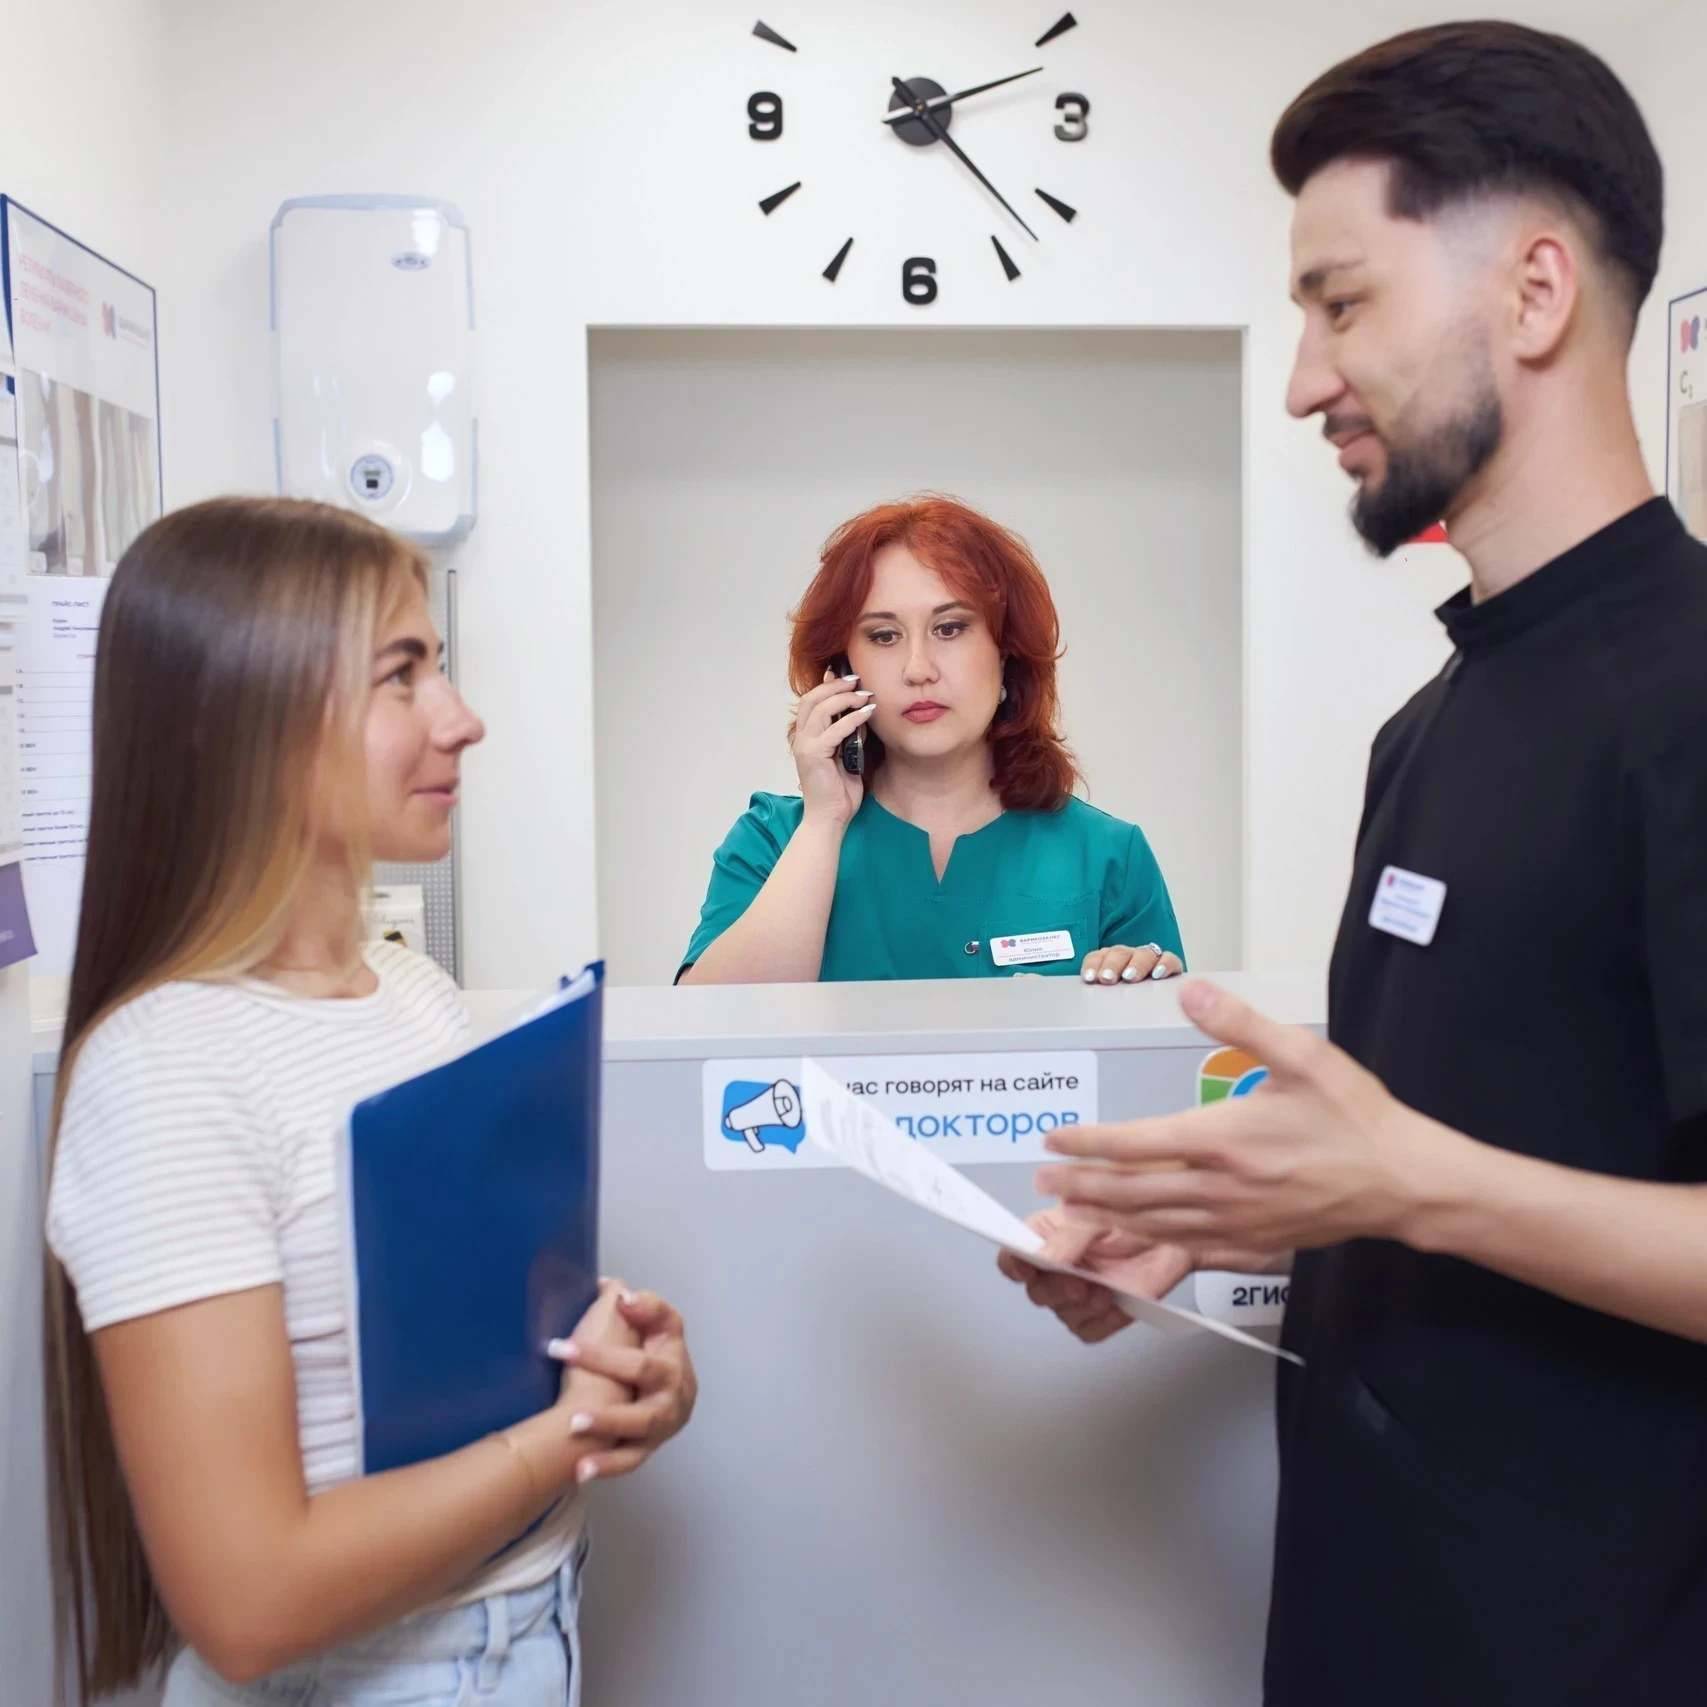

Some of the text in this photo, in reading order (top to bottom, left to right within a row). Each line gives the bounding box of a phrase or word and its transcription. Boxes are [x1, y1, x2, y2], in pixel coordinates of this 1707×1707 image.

[747, 91, 783, 141] 9
[1054, 92, 1090, 142] 3
[902, 257, 938, 305] 6
[885, 1079, 974, 1098] говорят
[980, 1079, 1007, 1092] на
[1013, 1072, 1079, 1091] сайте
